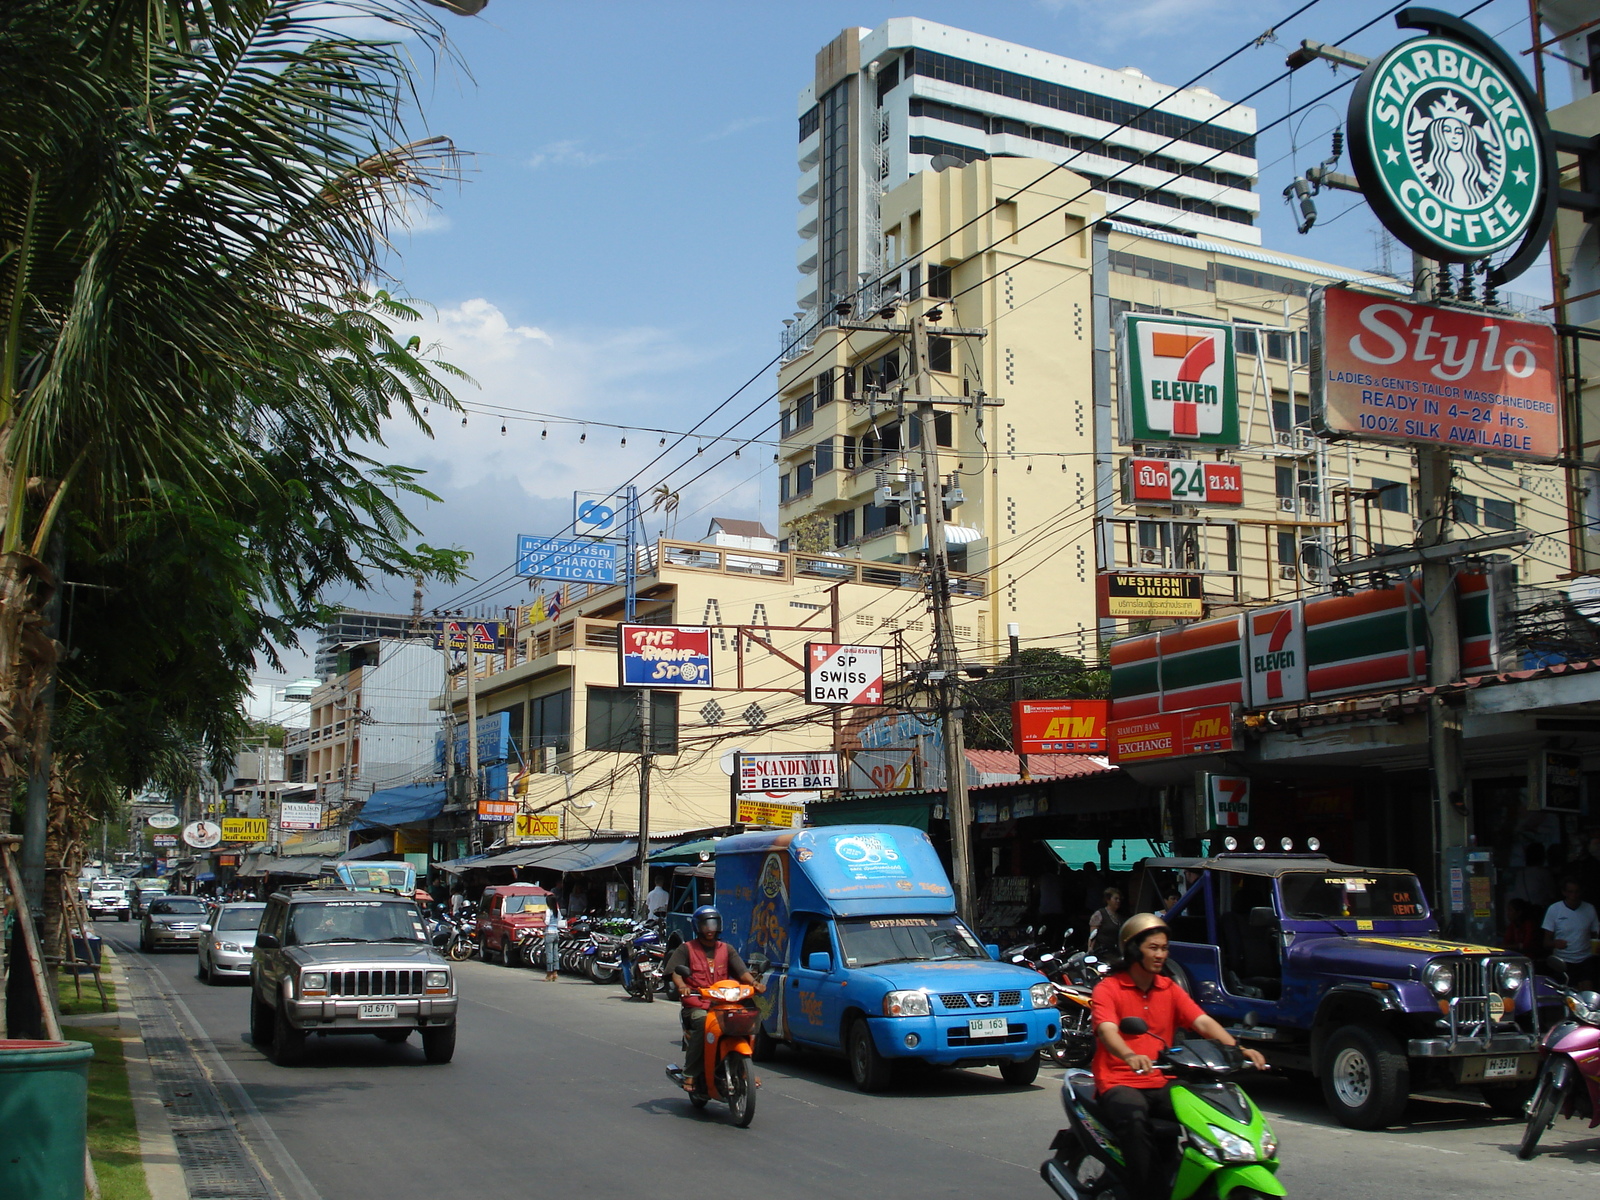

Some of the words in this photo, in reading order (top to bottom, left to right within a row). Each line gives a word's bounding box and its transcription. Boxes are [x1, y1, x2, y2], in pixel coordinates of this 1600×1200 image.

[1376, 48, 1530, 151] STARBUCKS
[1400, 178, 1521, 243] COFFEE
[1349, 303, 1536, 381] Stylo
[1328, 370, 1372, 386] LADIES
[1374, 379, 1381, 387] &
[1381, 376, 1419, 393] GENTS
[1422, 382, 1461, 399] TAILOR
[1464, 389, 1555, 414] MASSCHNEIDEREI
[1362, 390, 1418, 413] READY
[1423, 399, 1440, 415] IN
[1499, 412, 1529, 429] Hrs.
[1359, 413, 1399, 433] 100%
[1405, 419, 1441, 438] SILK
[1449, 426, 1532, 450] AVAILABLE
[1139, 464, 1168, 487] เปิด
[1171, 467, 1205, 497] 24
[554, 555, 613, 570] CHAROEN
[528, 564, 606, 580] OPTICAL
[1116, 576, 1180, 587] WESTERN
[1137, 586, 1181, 597] UNION
[631, 630, 675, 646] THE
[837, 655, 857, 668] SP
[820, 670, 867, 684] SWISS
[815, 686, 849, 700] BAR
[1043, 716, 1096, 739] ATM
[1191, 718, 1221, 739] ATM
[1118, 738, 1173, 754] EXCHANGE
[756, 760, 836, 777] SCANDINAVIA
[762, 778, 797, 788] BEER
[803, 776, 832, 787] BAR
[1393, 892, 1411, 903] CAR
[1392, 904, 1415, 915] RENT
[375, 1004, 395, 1013] 6717
[989, 1019, 1003, 1029] 163
